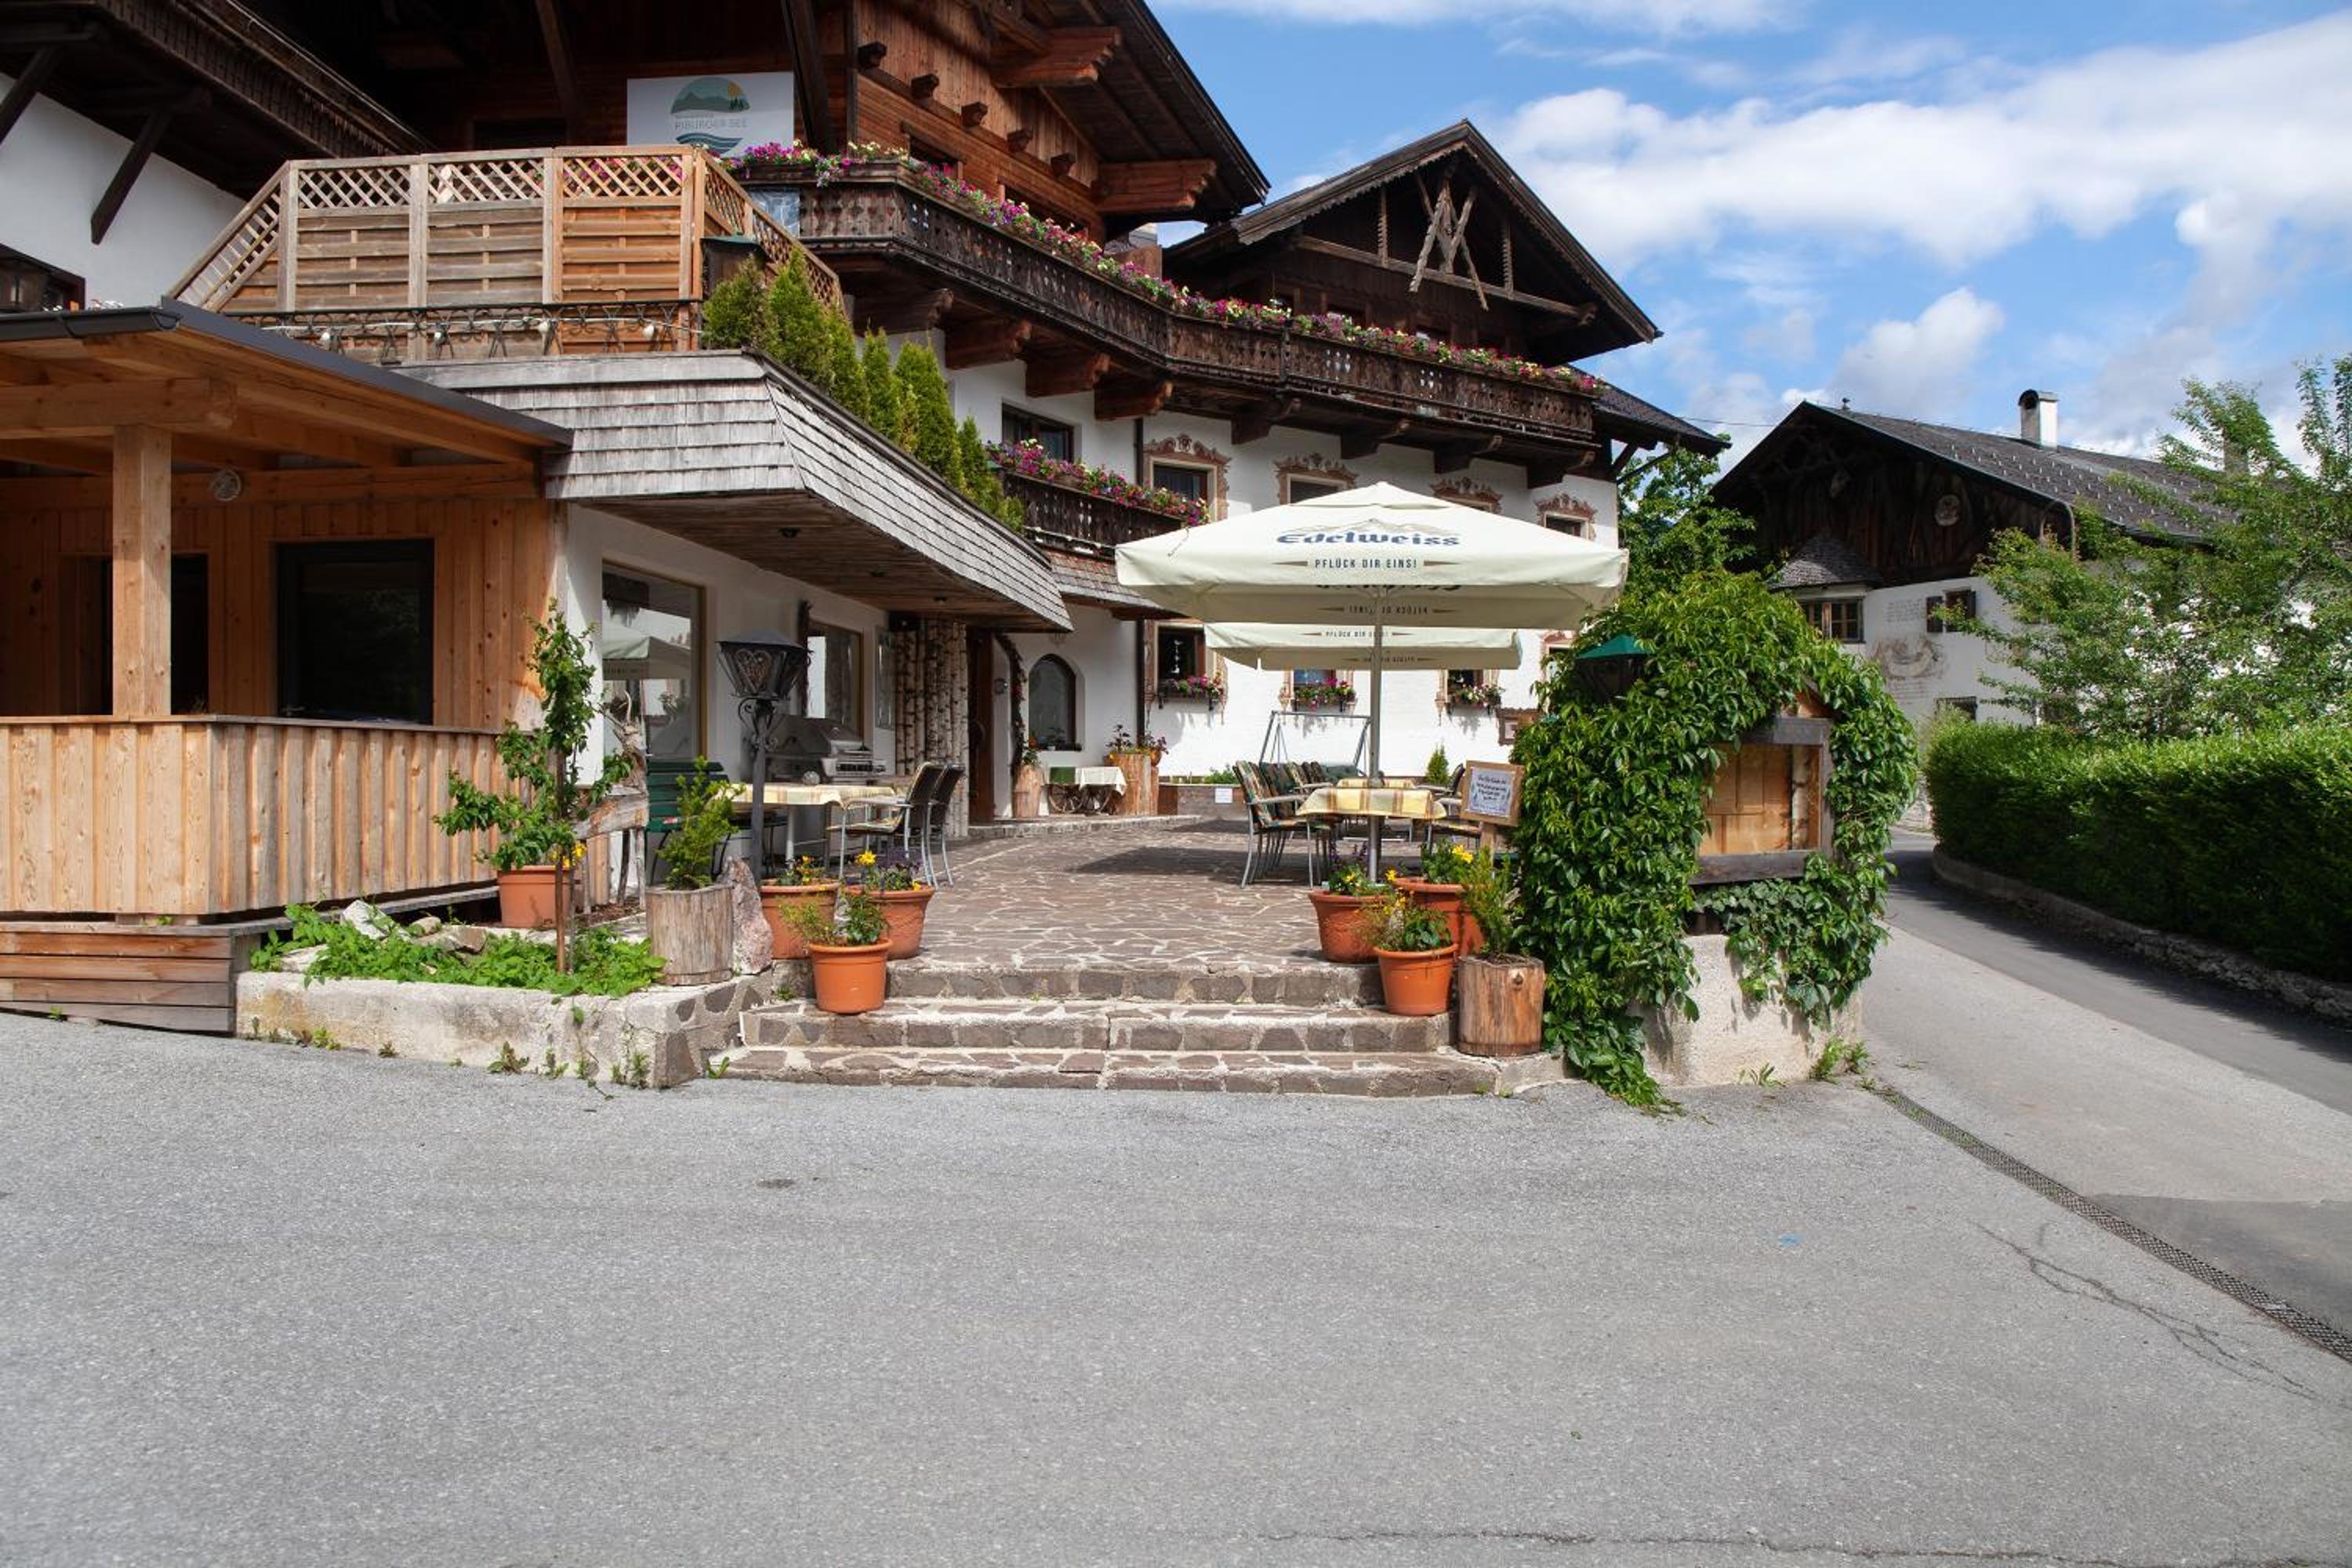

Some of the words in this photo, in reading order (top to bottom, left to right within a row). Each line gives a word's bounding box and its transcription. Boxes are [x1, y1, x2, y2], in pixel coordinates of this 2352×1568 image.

[1276, 531, 1461, 546] Edelweiss
[1315, 557, 1356, 568] PFLÜCK
[1362, 559, 1381, 568] DIR
[1386, 559, 1417, 568] EINS!
